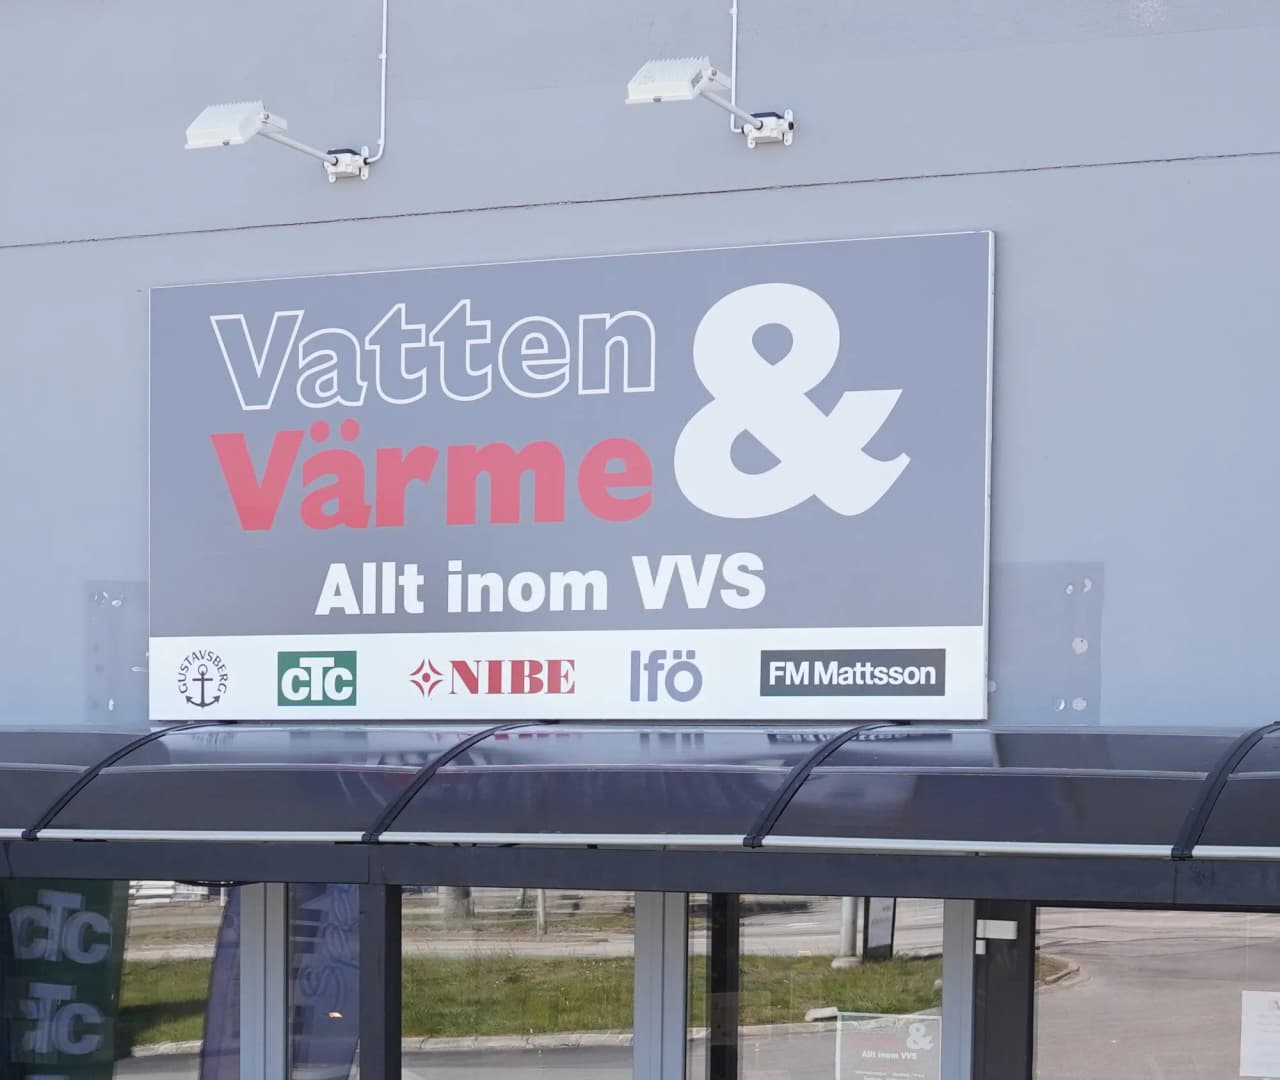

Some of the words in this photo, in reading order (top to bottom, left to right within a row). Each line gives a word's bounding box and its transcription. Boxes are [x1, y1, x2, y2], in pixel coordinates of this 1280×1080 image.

[210, 299, 656, 411] Vatten
[673, 282, 911, 519] &
[210, 418, 653, 531] Värme
[315, 562, 425, 615] Allt
[447, 560, 608, 613] inom
[632, 552, 766, 611] VVS
[177, 649, 229, 695] GUSTAVSBERG
[281, 656, 353, 701] CTC
[449, 659, 575, 694] NIBE
[769, 660, 810, 686] FM
[814, 659, 937, 686] Mattsson
